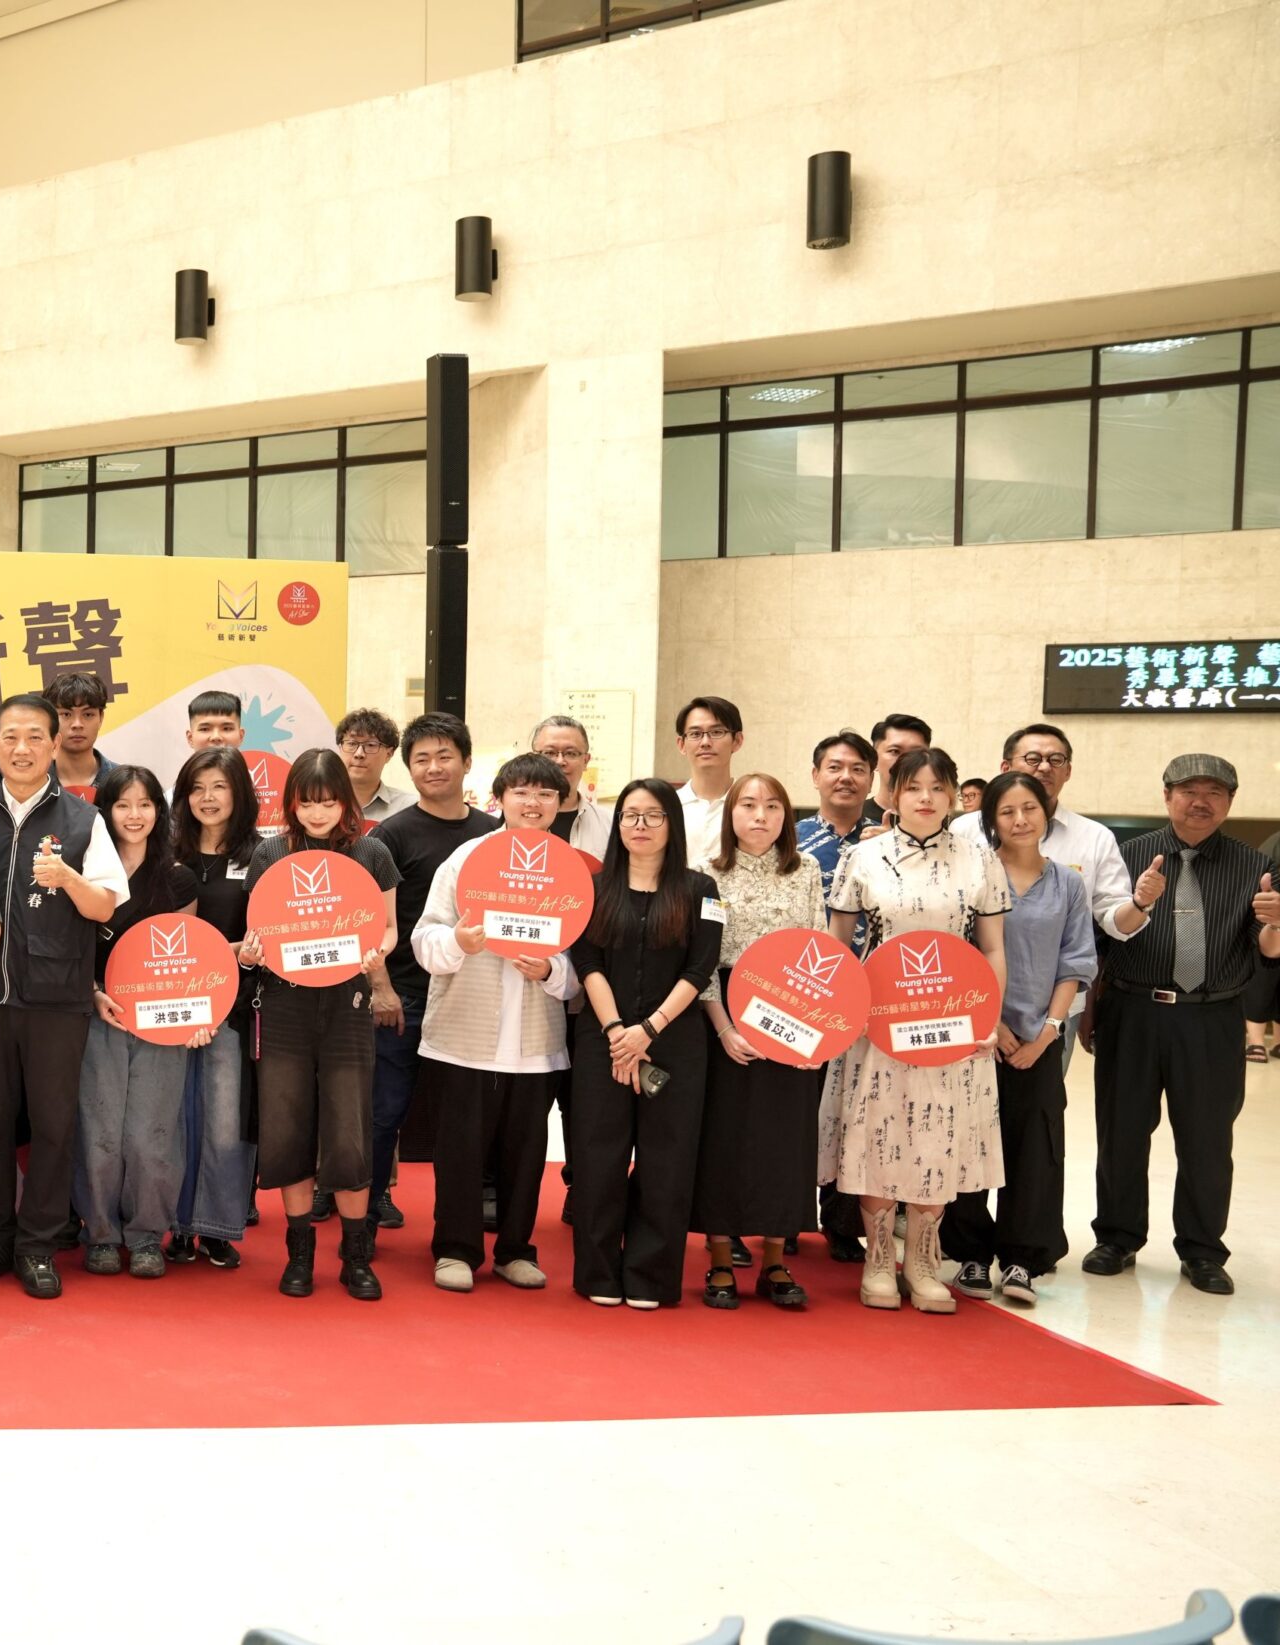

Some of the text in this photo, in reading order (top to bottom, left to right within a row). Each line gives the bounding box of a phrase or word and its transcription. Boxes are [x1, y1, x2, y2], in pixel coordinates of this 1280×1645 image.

[237, 623, 268, 632] Voices
[1059, 644, 1238, 668] 2025藝術新聲
[499, 870, 554, 883] Young Voices
[286, 895, 342, 908] Young Voices
[536, 896, 558, 913] Art
[559, 894, 584, 912] Star
[331, 914, 351, 936] Art
[353, 908, 376, 928] Star
[143, 957, 197, 969] Young Voices
[300, 950, 340, 966] 盧宛萱
[185, 977, 203, 996] Art
[206, 971, 228, 990] Star
[781, 965, 834, 998] Young Voices
[895, 975, 953, 989] Young Voices
[869, 989, 990, 1016] 025藝術星勢力 Art Star
[154, 1010, 192, 1024] 洪雪寧
[802, 1006, 826, 1023] Art
[825, 1013, 853, 1032] Star
[758, 1015, 796, 1044] 羅苡心
[910, 1031, 951, 1046] 林庭薰
